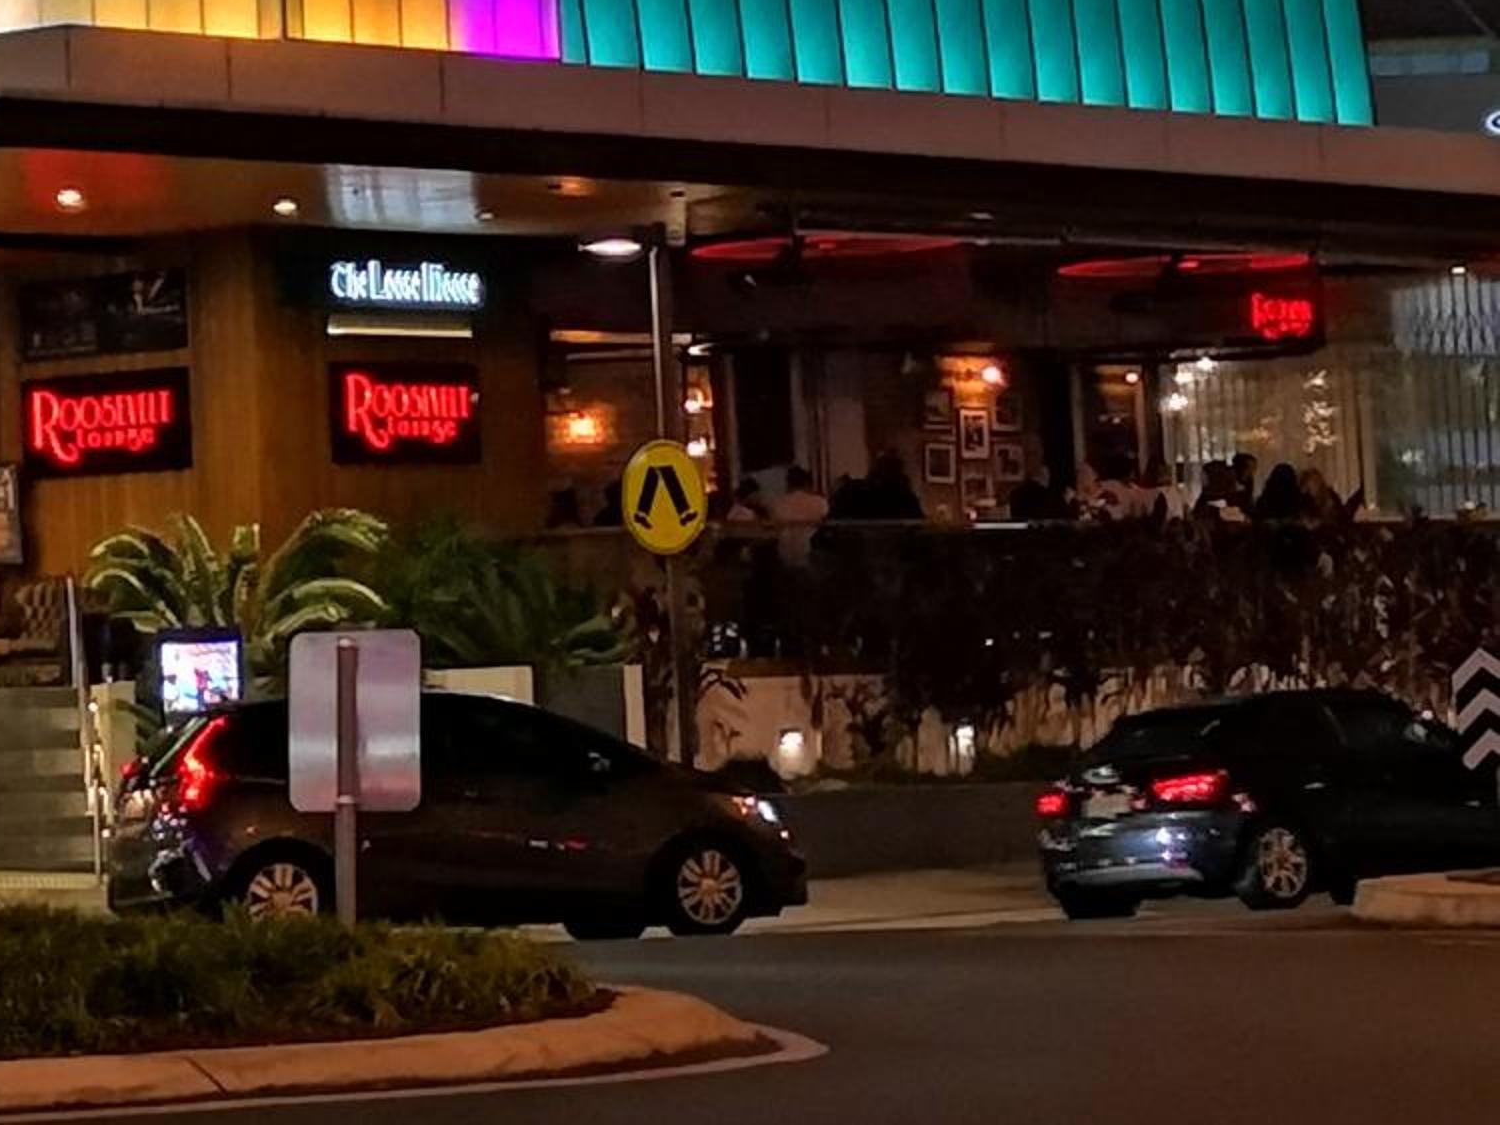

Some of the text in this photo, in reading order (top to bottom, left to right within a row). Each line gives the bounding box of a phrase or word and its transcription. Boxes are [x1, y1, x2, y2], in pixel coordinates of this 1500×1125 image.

[330, 260, 368, 301] The
[32, 389, 172, 464] ROOSEVELT
[345, 373, 470, 450] ROOSEVELT
